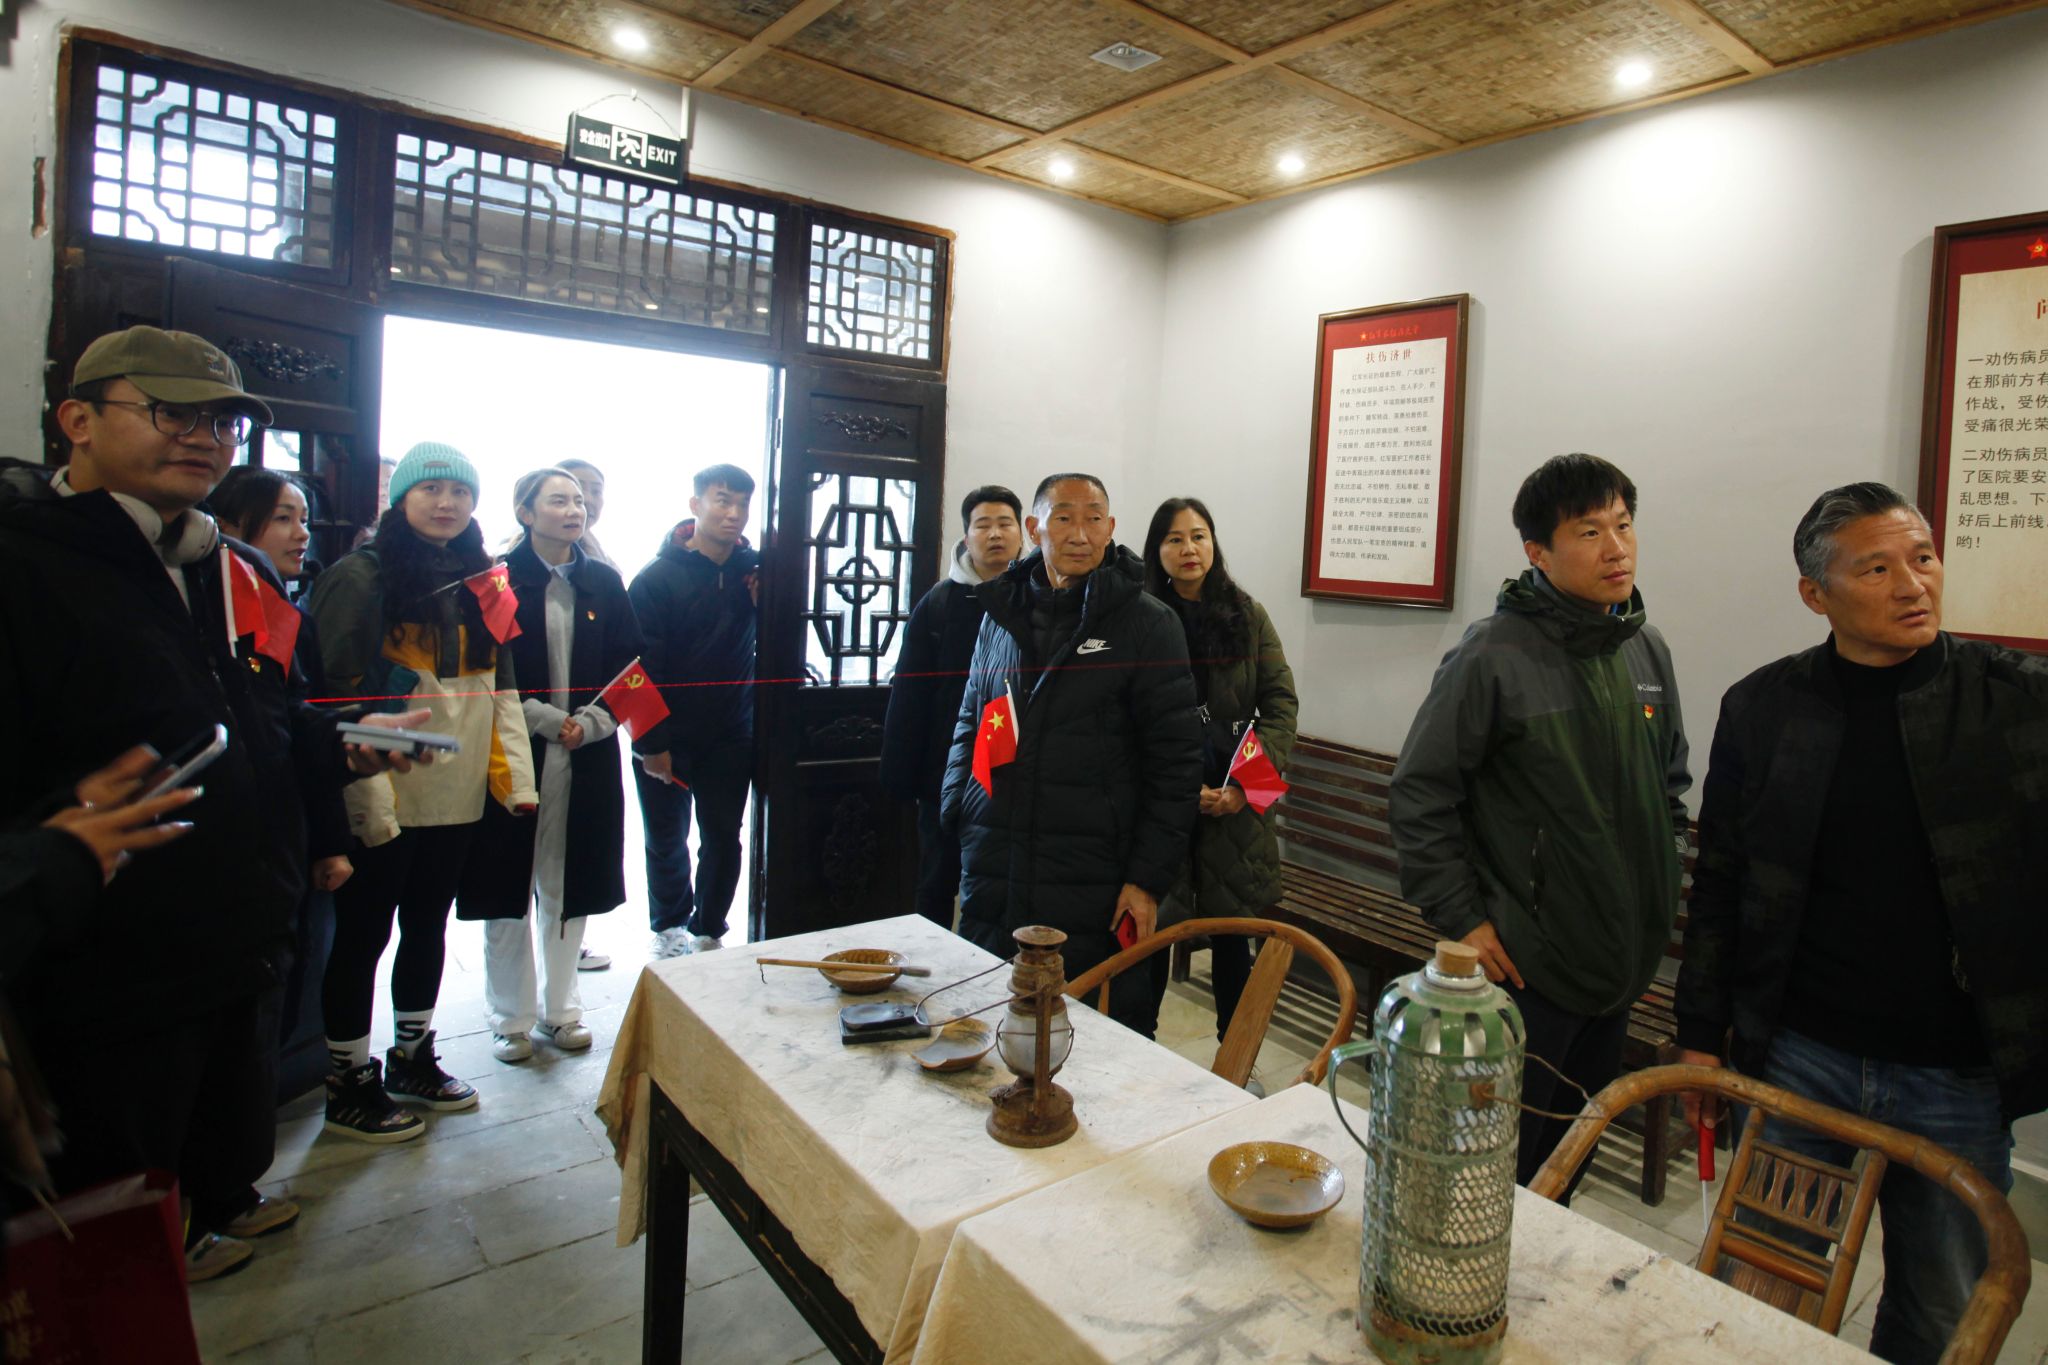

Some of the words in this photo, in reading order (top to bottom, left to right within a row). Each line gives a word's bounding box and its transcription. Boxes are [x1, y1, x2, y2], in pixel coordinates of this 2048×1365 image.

[648, 145, 677, 165] EXIT
[1365, 347, 1413, 364] 扶伤济世
[1967, 349, 2048, 367] 一劝伤病员
[1966, 371, 2048, 389] 在那前方有
[1965, 393, 2048, 412] 作战，受伤
[1964, 416, 2048, 433] 受痛很光荣
[1962, 447, 2048, 462] 二劝伤病员
[1962, 469, 2048, 484] 了医院要安
[1959, 491, 2048, 506] 乱思想。下
[1083, 639, 1107, 648] NIKE
